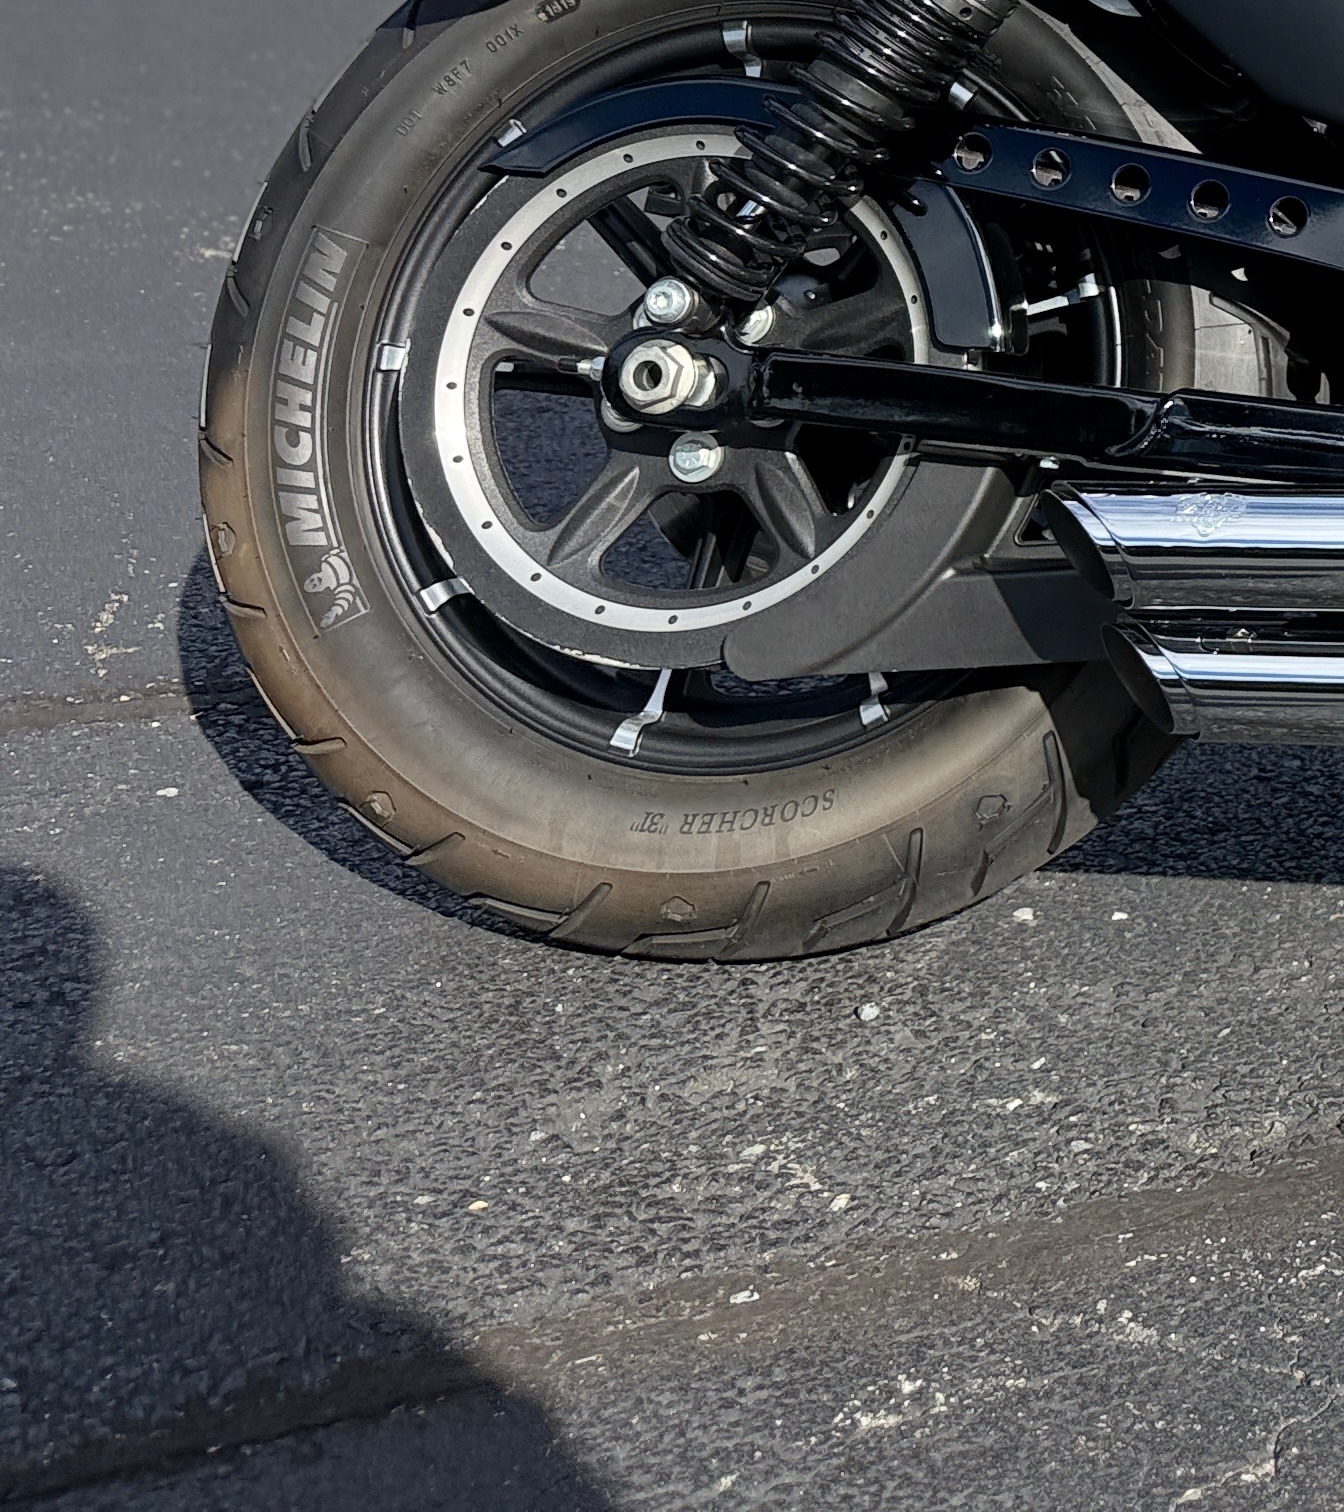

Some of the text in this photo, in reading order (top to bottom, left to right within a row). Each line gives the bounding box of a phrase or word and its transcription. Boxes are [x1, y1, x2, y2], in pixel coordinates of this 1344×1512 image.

[431, 57, 474, 97] W8F7
[273, 230, 349, 547] MICHELIN
[678, 787, 836, 835] SCORCHER
